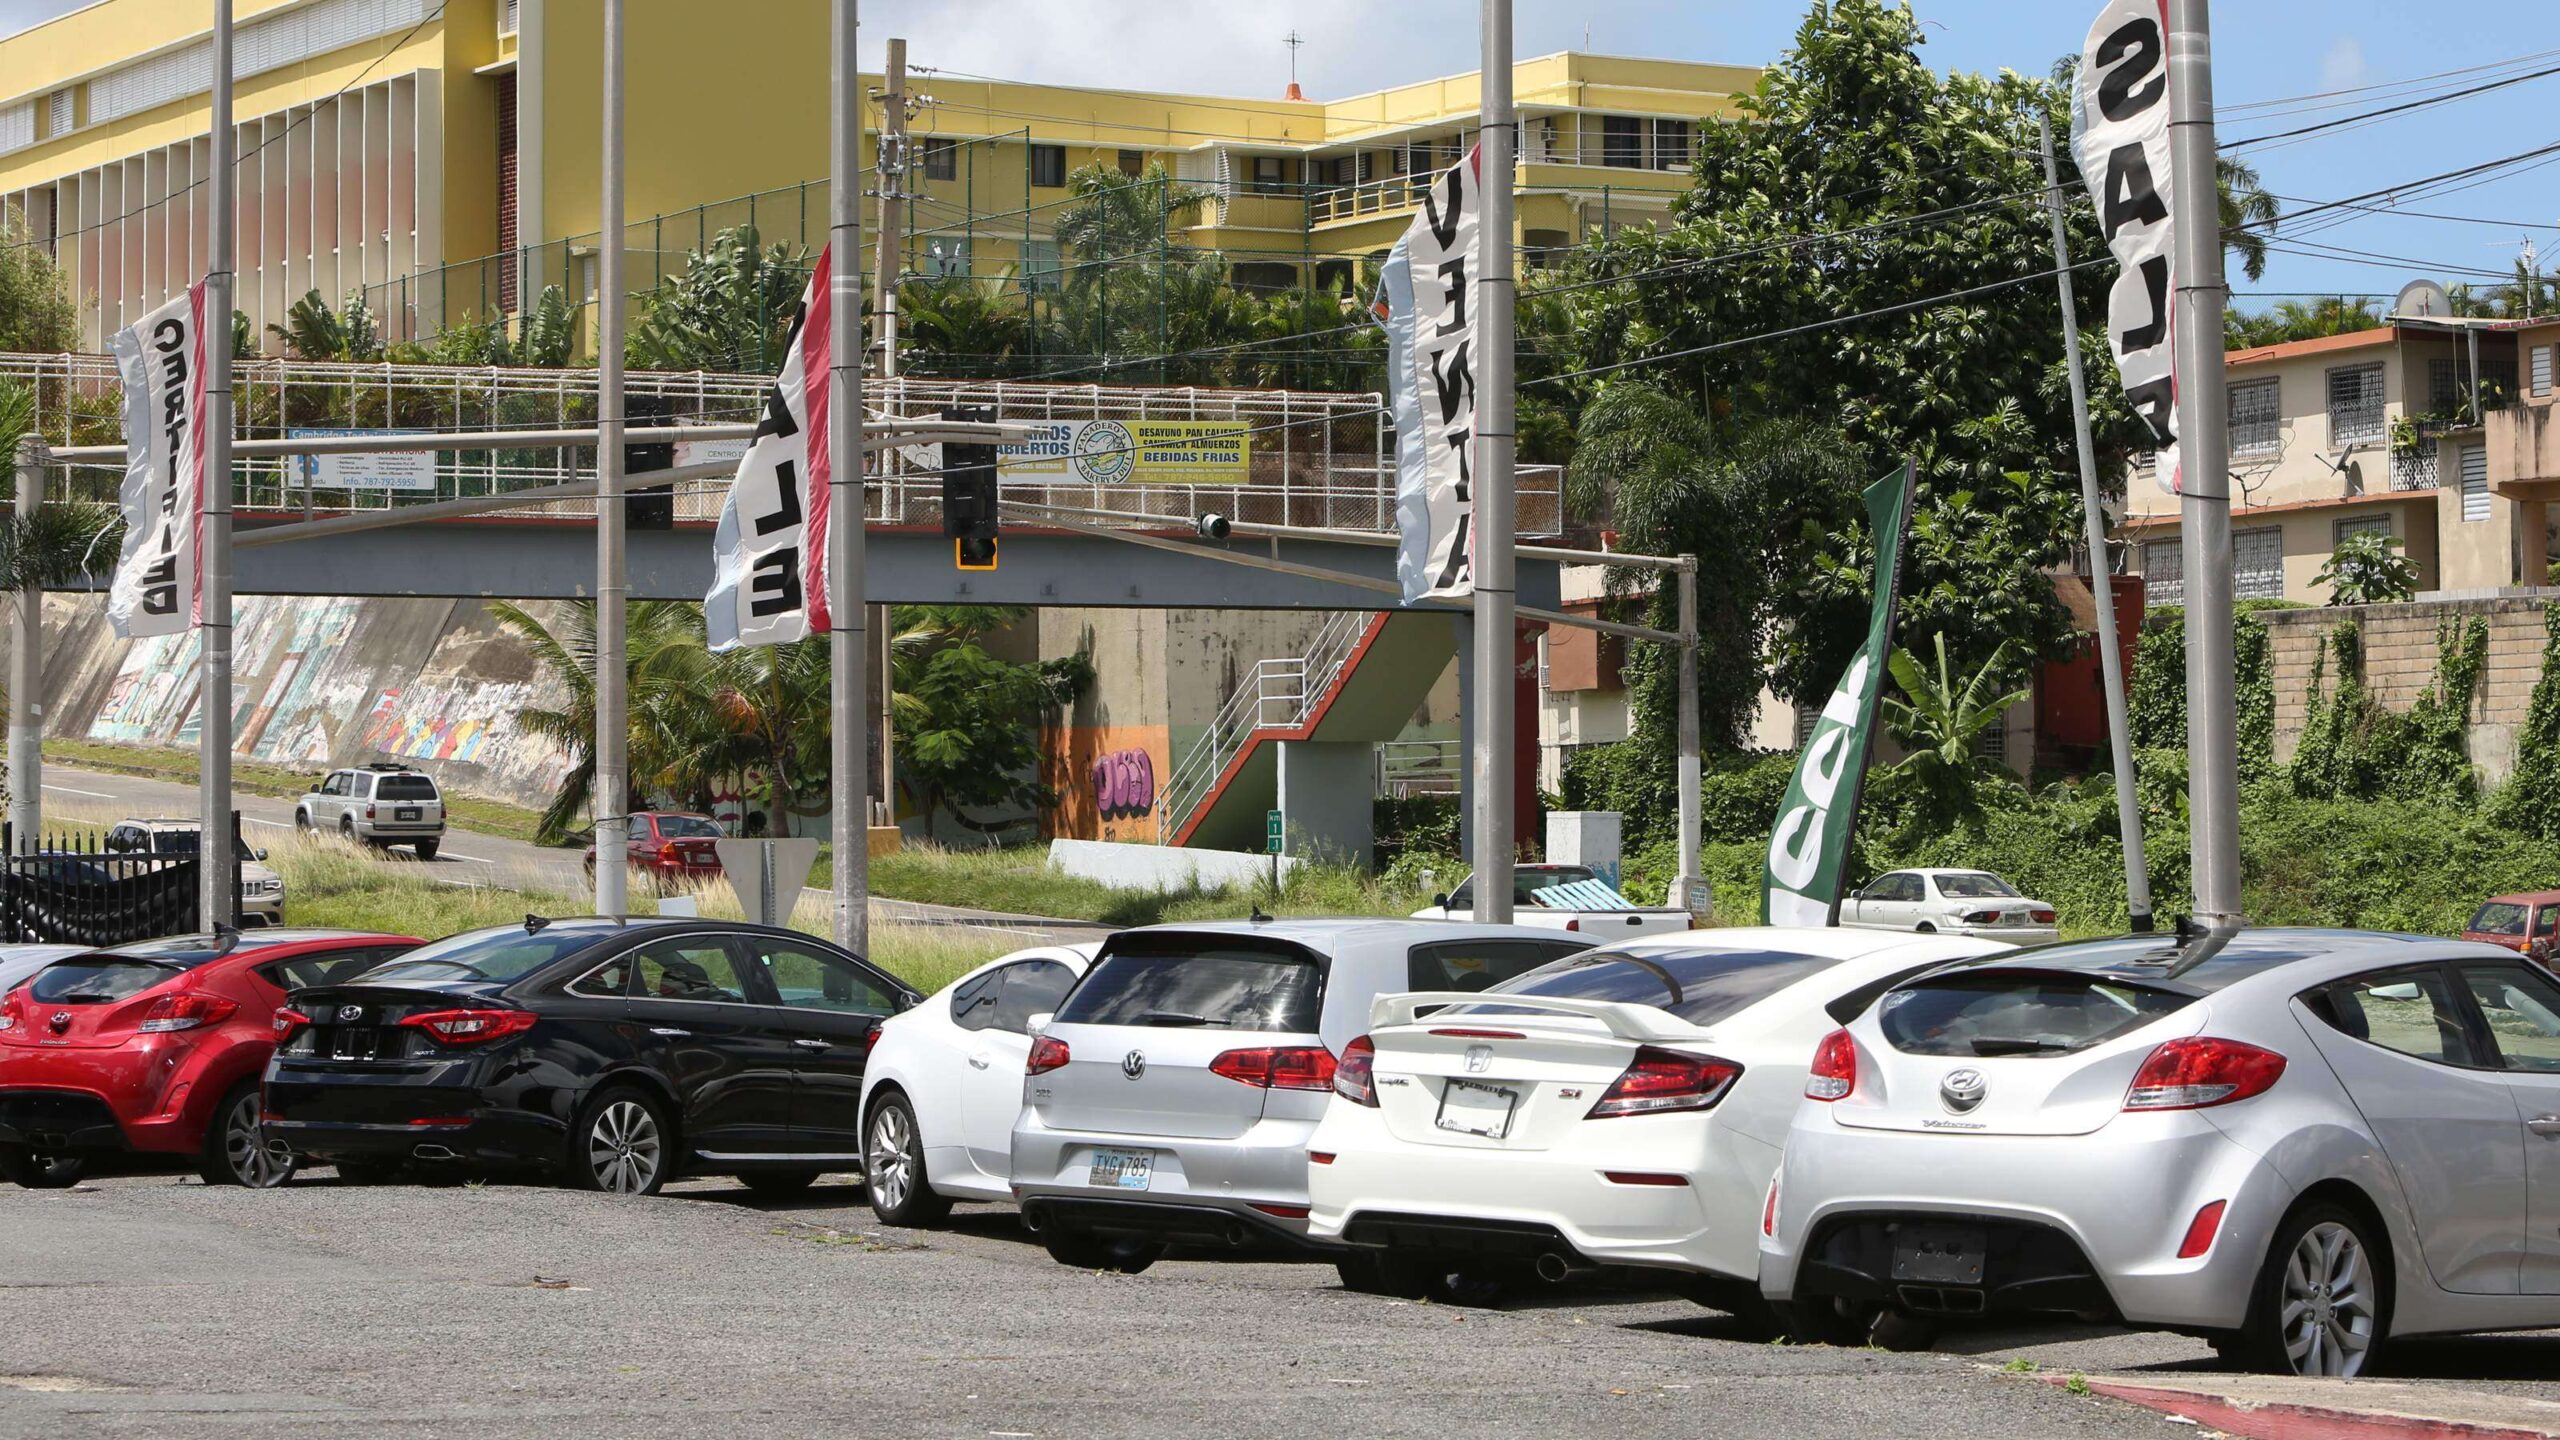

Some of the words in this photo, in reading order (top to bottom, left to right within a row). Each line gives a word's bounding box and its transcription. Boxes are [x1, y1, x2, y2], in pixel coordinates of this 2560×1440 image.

[1139, 428, 1182, 437] DESAYUNO
[1186, 428, 1203, 437] PAN
[1191, 440, 1241, 449] ALMUERZOS
[707, 450, 738, 458] CENTRO
[1144, 452, 1198, 463] BEBIDAS
[1202, 452, 1240, 463] FRIAS
[1080, 464, 1111, 484] BAKERY
[1117, 456, 1133, 478] DELI
[364, 477, 416, 487] 787-792-5950
[1125, 1156, 1149, 1177] 785
